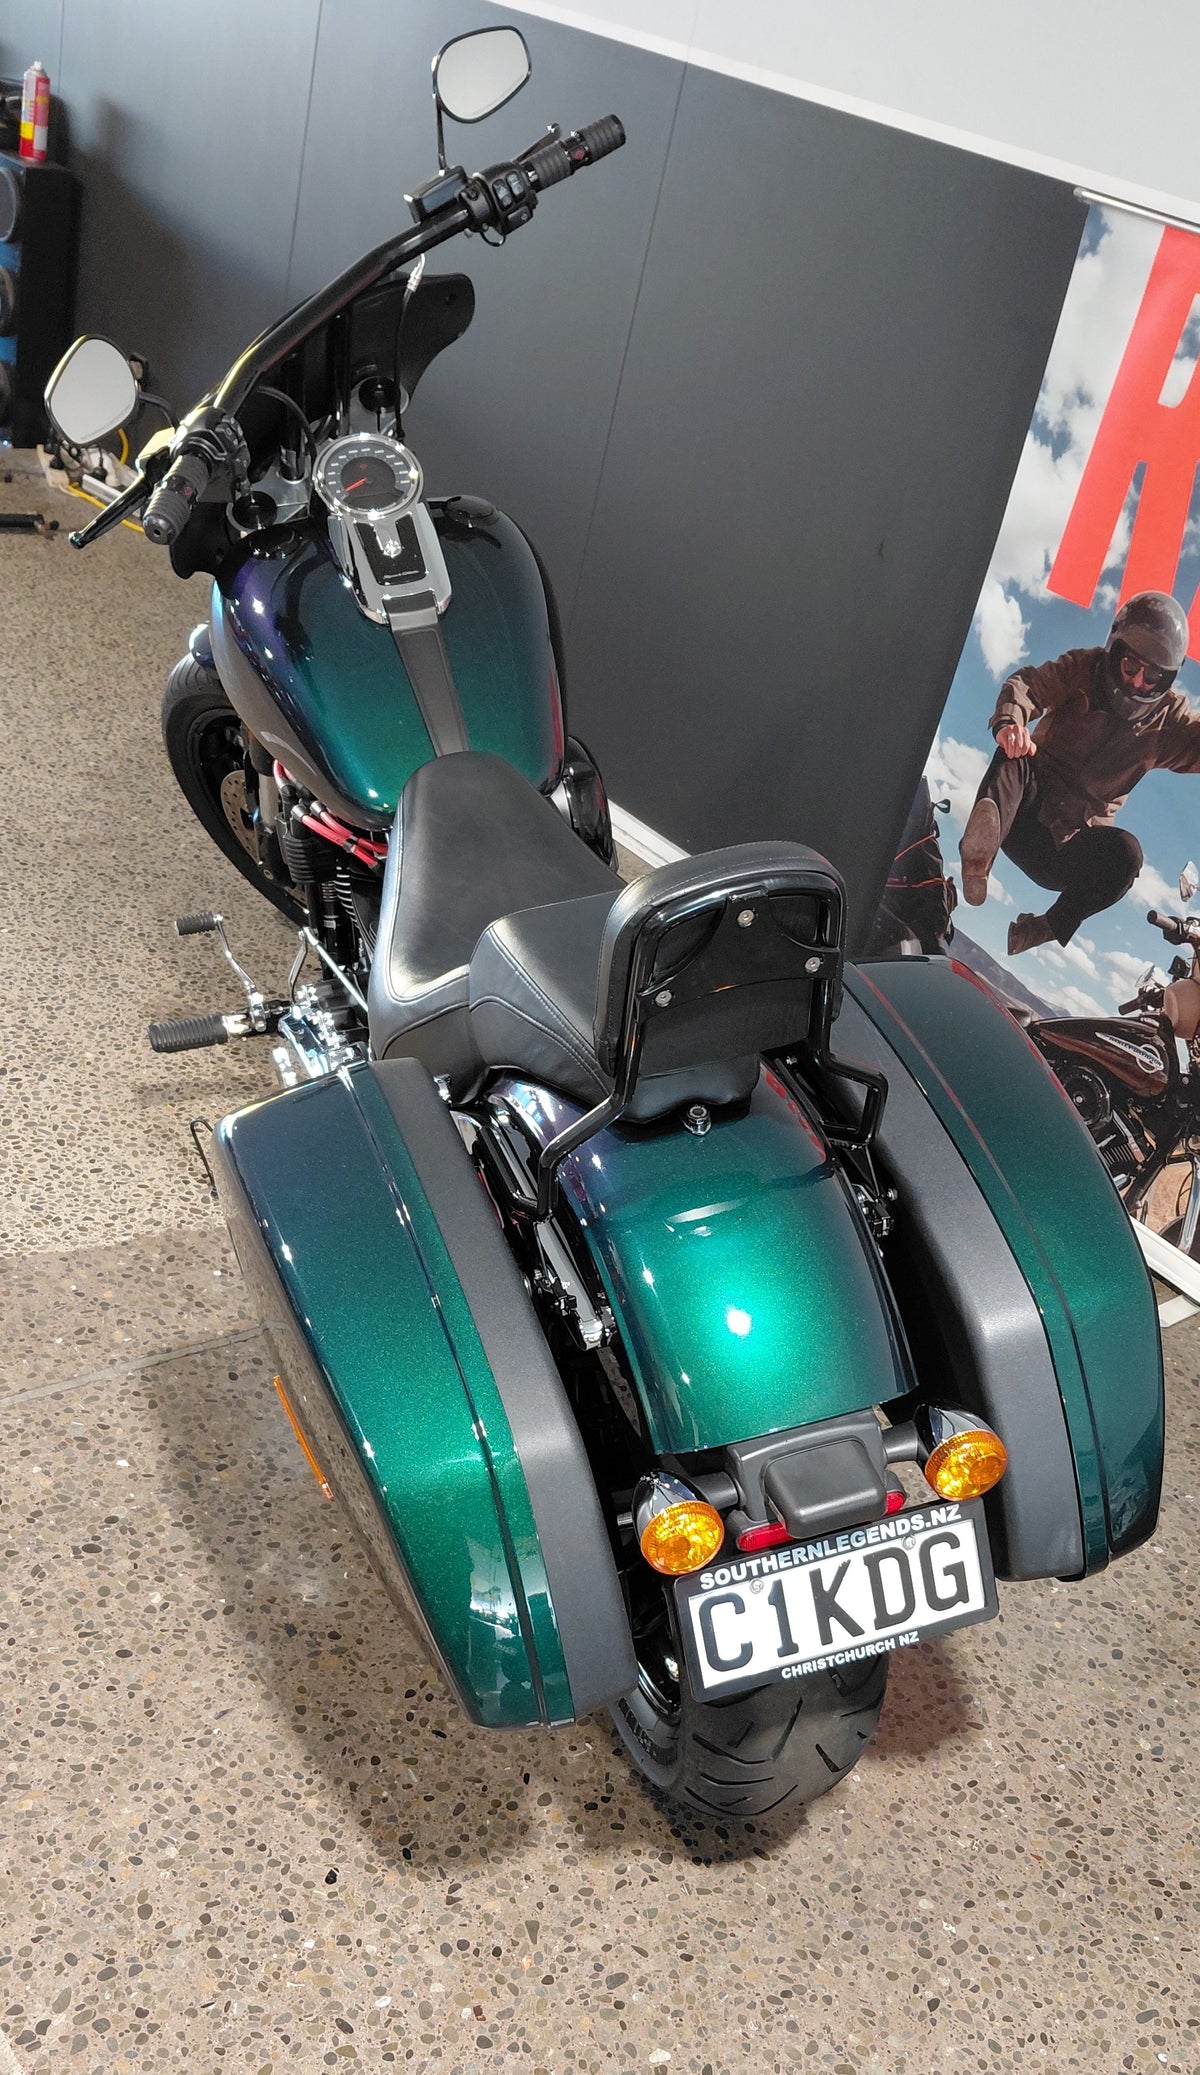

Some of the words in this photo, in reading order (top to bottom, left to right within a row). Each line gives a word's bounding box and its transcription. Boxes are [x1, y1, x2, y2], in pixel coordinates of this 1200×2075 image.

[699, 1504, 961, 1589] SOUTHERNLEGENDS.NZ
[699, 1531, 969, 1672] C1KDG
[781, 1636, 895, 1679] CHRISTCHURCH
[899, 1631, 919, 1649] NZ
